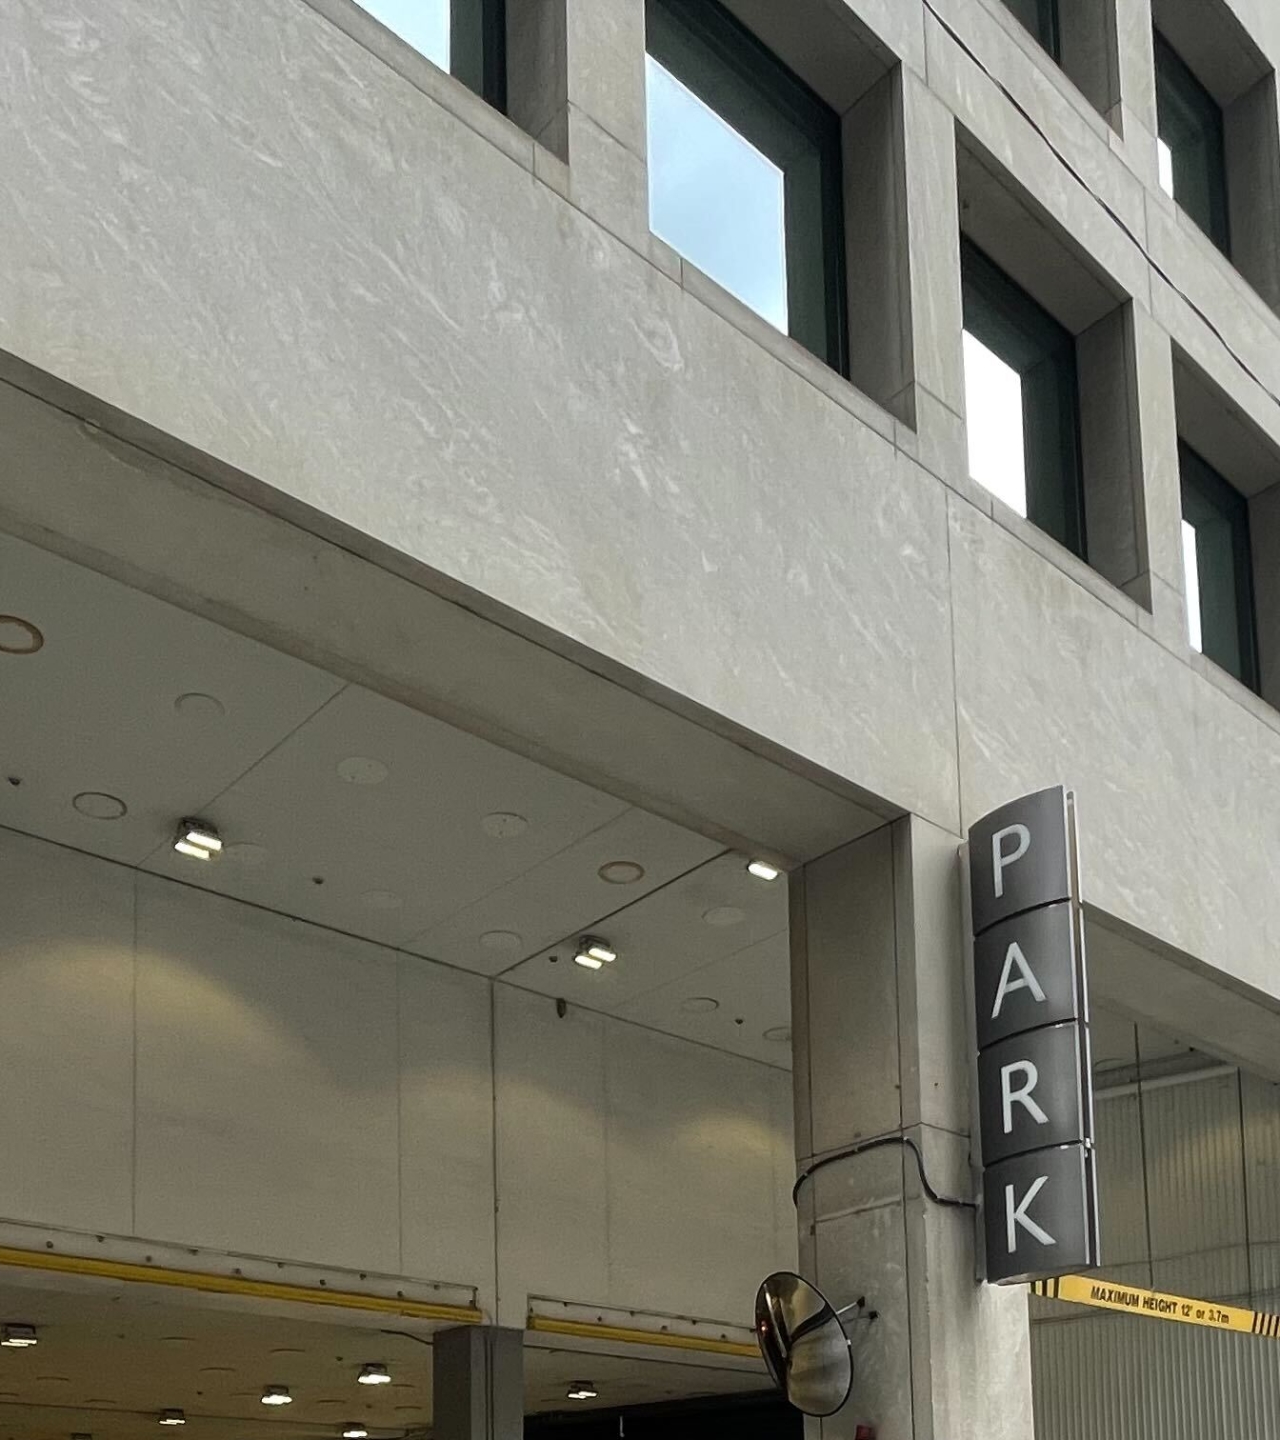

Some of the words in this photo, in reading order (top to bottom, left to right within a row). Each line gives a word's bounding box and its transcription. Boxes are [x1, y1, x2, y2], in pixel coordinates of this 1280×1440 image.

[991, 823, 1056, 1253] PARK
[1091, 1286, 1139, 1307] MAXIMUM
[1142, 1299, 1177, 1314] HEIGHT
[1196, 1310, 1205, 1319] or
[1208, 1309, 1229, 1324] 3.7m
